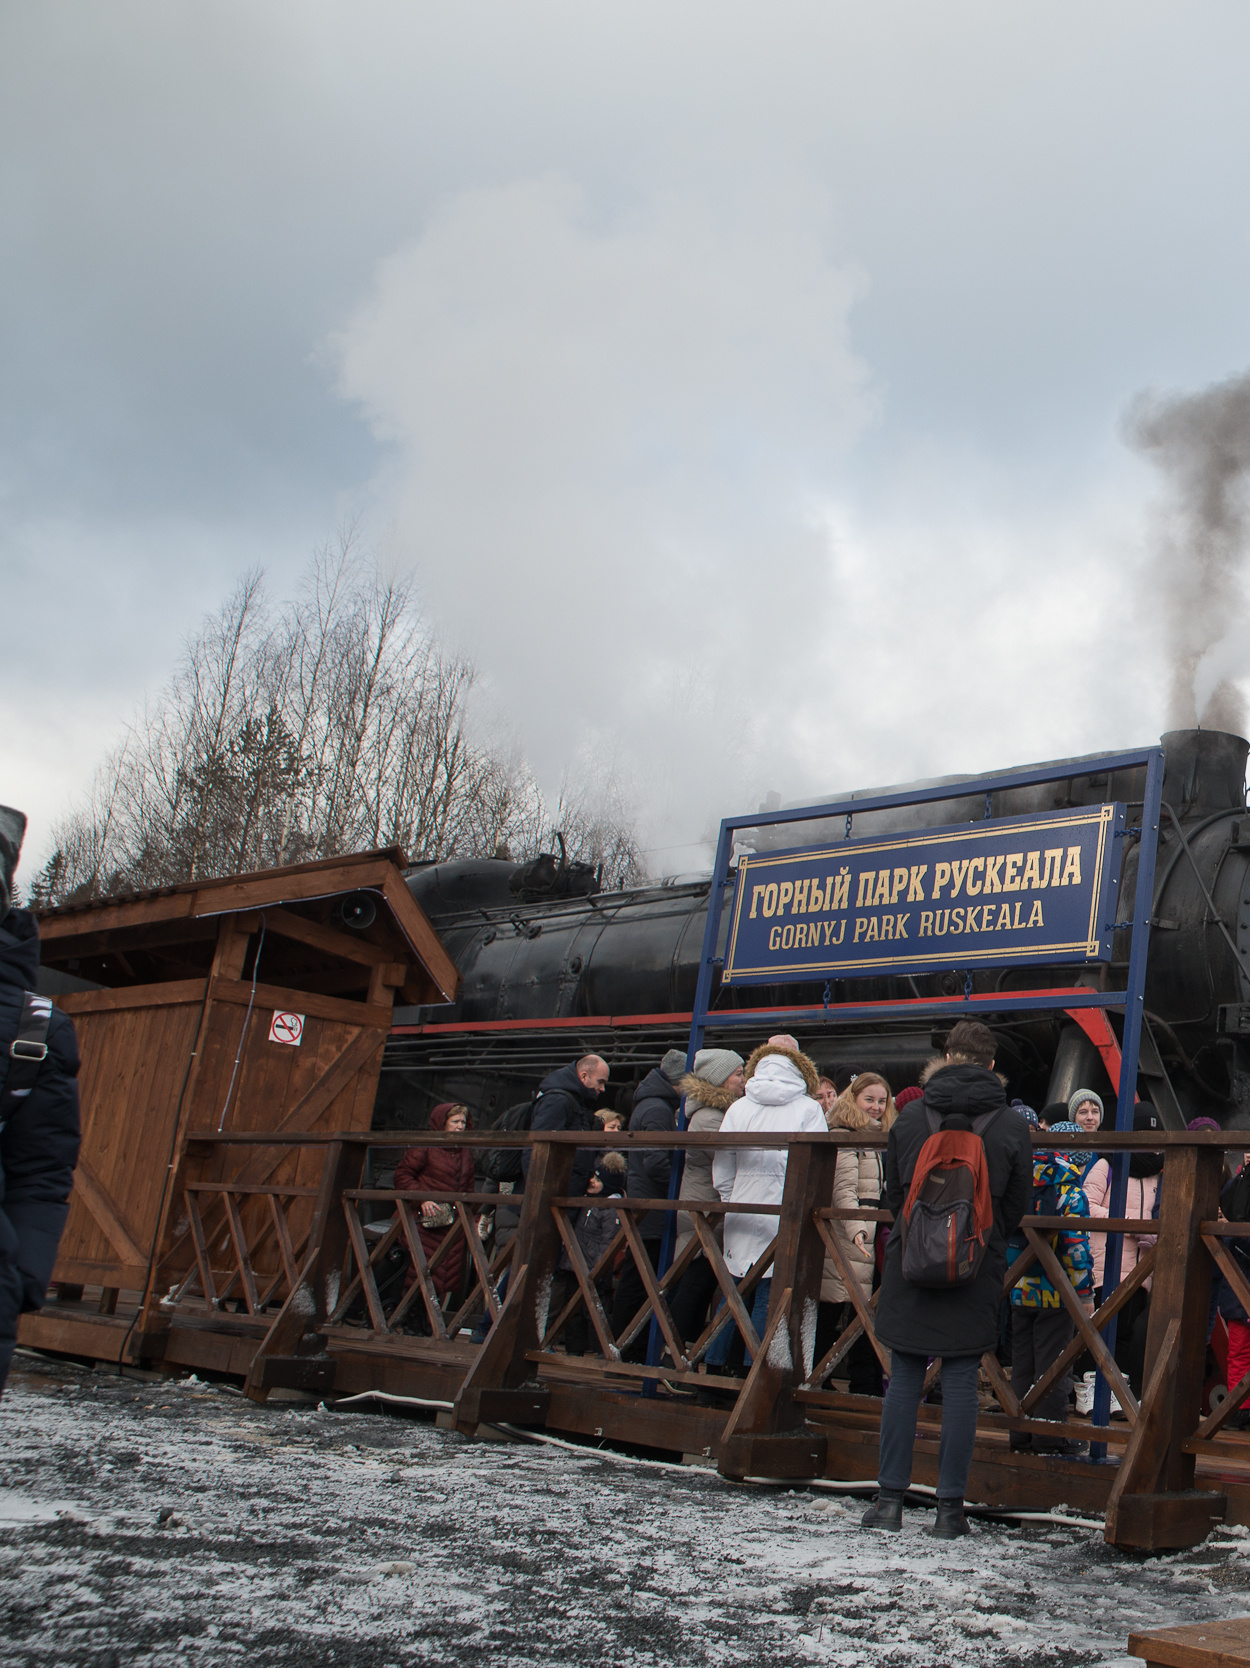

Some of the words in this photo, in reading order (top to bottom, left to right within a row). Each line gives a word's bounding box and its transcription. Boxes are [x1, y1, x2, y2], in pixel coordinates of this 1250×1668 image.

[748, 866, 852, 919] ГОРНЫЙ
[855, 864, 929, 908] ПАРК
[931, 845, 1082, 900] РУСКЕАЛА
[767, 919, 846, 951] GORNYJ
[852, 912, 912, 944] PARK
[917, 899, 1045, 938] RUSKEALA
